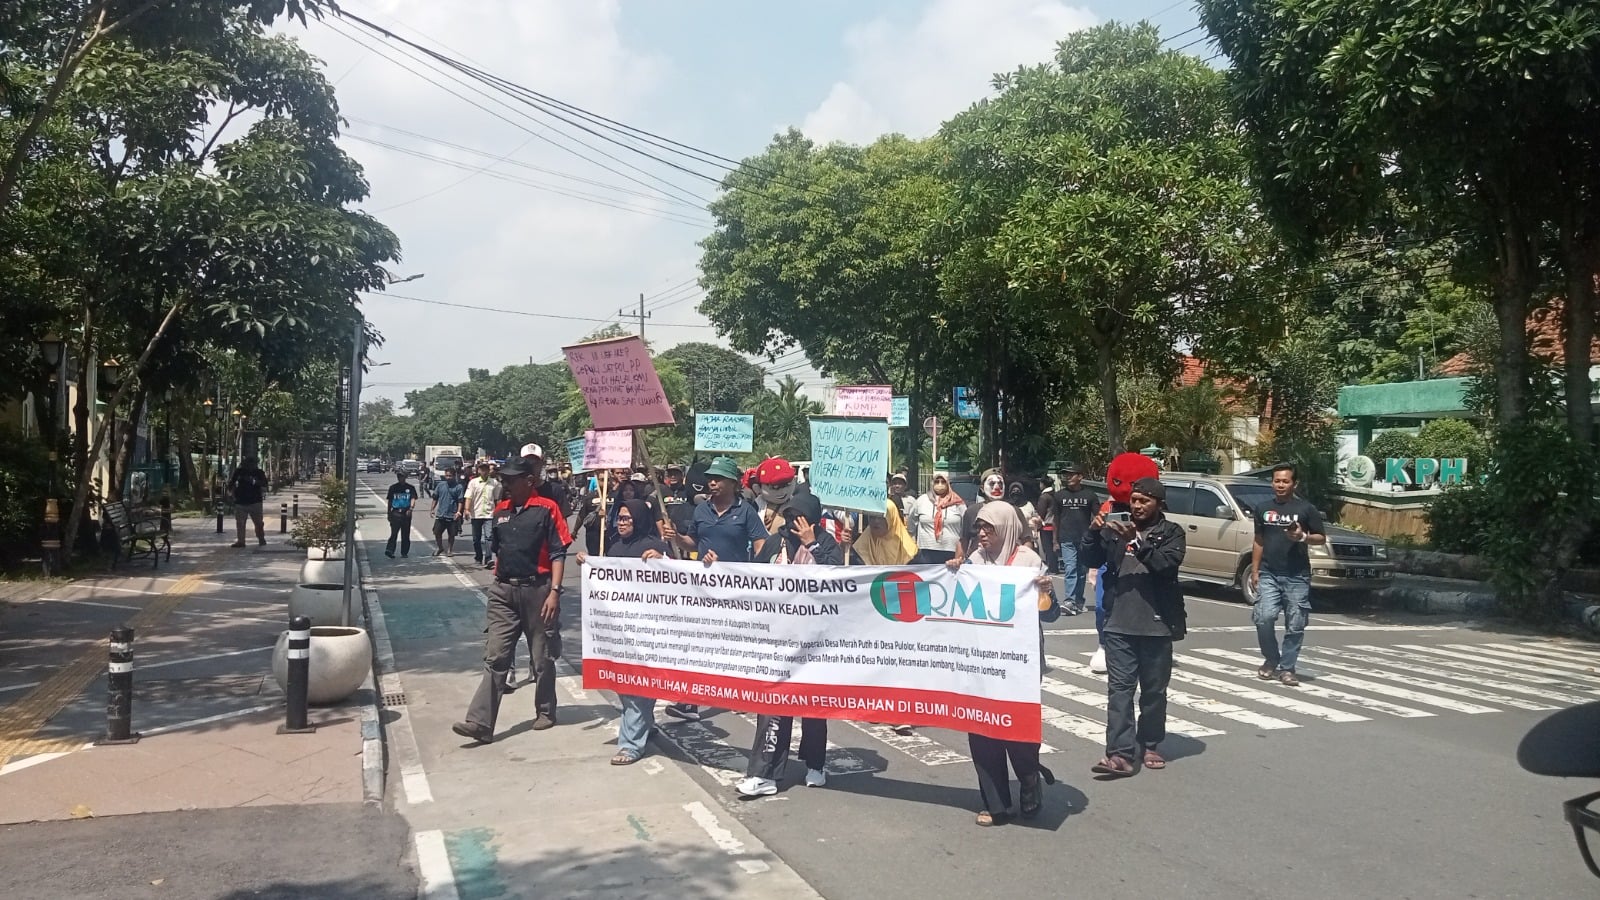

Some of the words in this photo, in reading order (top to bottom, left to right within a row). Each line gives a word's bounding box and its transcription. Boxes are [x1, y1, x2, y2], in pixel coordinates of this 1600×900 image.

[815, 426, 842, 442] KAMU
[845, 427, 878, 443] BUAT
[814, 443, 843, 460] PERDA
[1386, 457, 1468, 485] KPH
[589, 568, 633, 582] FORUM
[636, 570, 688, 585] REMBUG
[690, 572, 774, 592] MASYARAKAT
[778, 578, 858, 593] JOMBANG
[589, 590, 610, 601] AKSI
[611, 591, 643, 603] DAMAI
[646, 594, 678, 605] UNTUK
[681, 596, 753, 611] TRANSPARANSI
[755, 601, 776, 613] DAN
[779, 604, 839, 616] KEADILAN
[825, 639, 839, 648] Desa
[840, 638, 857, 649] Merah
[858, 639, 873, 649] Putih
[880, 640, 894, 650] Desa
[917, 642, 948, 653] Kecamatan
[971, 647, 999, 660] Kabupaten
[862, 655, 876, 665] Desa
[898, 657, 929, 668] Kecamatan
[956, 661, 980, 674] Kabupaten
[981, 665, 1006, 679] Jombang
[617, 674, 649, 687] BUKAN
[651, 678, 689, 695] PILIHAN,
[691, 683, 740, 700] BERSAMA
[741, 688, 809, 706] WUJUDKAN
[811, 695, 894, 712] PERUBAHAN
[898, 700, 911, 713] DI
[915, 701, 949, 716] BUMI
[951, 706, 1012, 727] JOMBANG
